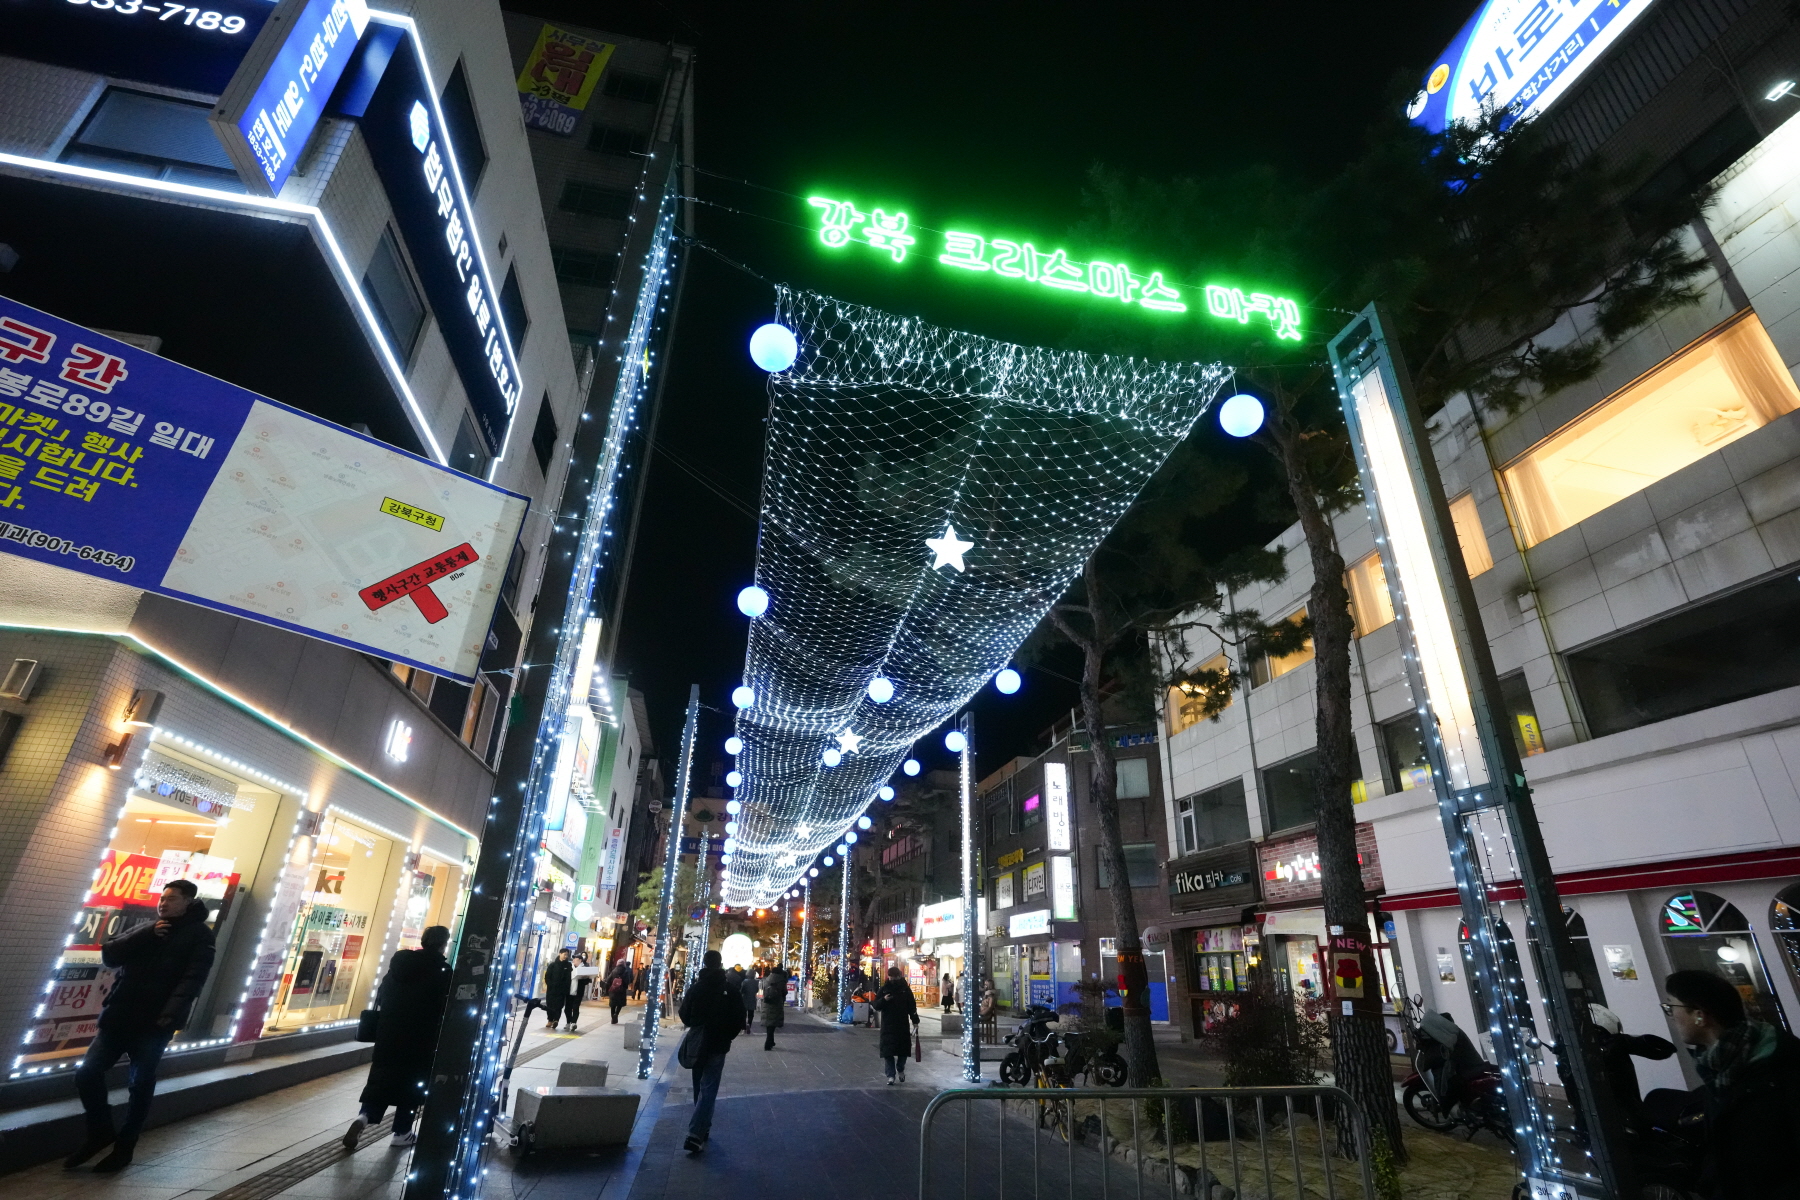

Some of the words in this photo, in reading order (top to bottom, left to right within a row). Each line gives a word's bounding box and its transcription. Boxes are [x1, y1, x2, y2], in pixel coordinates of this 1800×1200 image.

[66, 0, 246, 34] 33-7189
[547, 30, 606, 53] 사무실
[1468, 0, 1581, 104] 바로
[530, 41, 596, 97] 임대
[1510, 34, 1585, 117] 방학사거리
[247, 131, 276, 182] 1833-7189
[252, 118, 281, 172] 변호사
[423, 141, 473, 283] 법무법인
[466, 274, 491, 338] 일로
[807, 196, 915, 263] 강북
[939, 229, 1188, 313] 크리스마스
[1204, 283, 1303, 341] 마켓
[0, 427, 138, 488] 시합니다.
[81, 431, 144, 465] 행사
[149, 421, 215, 460] 일대
[29, 466, 101, 503] 드려
[388, 502, 437, 527] 강북구청
[371, 573, 423, 602] 행사구간
[422, 550, 470, 579] 교통통제
[449, 571, 465, 582] 80m
[1051, 780, 1065, 827] 노래방
[91, 860, 155, 901] 아이폰
[315, 869, 346, 895] kt
[1028, 875, 1044, 893] 디자인
[1175, 872, 1205, 894] fika
[1205, 870, 1224, 888] 피카
[310, 909, 331, 926] 아이폰
[1336, 938, 1367, 952] NEW
